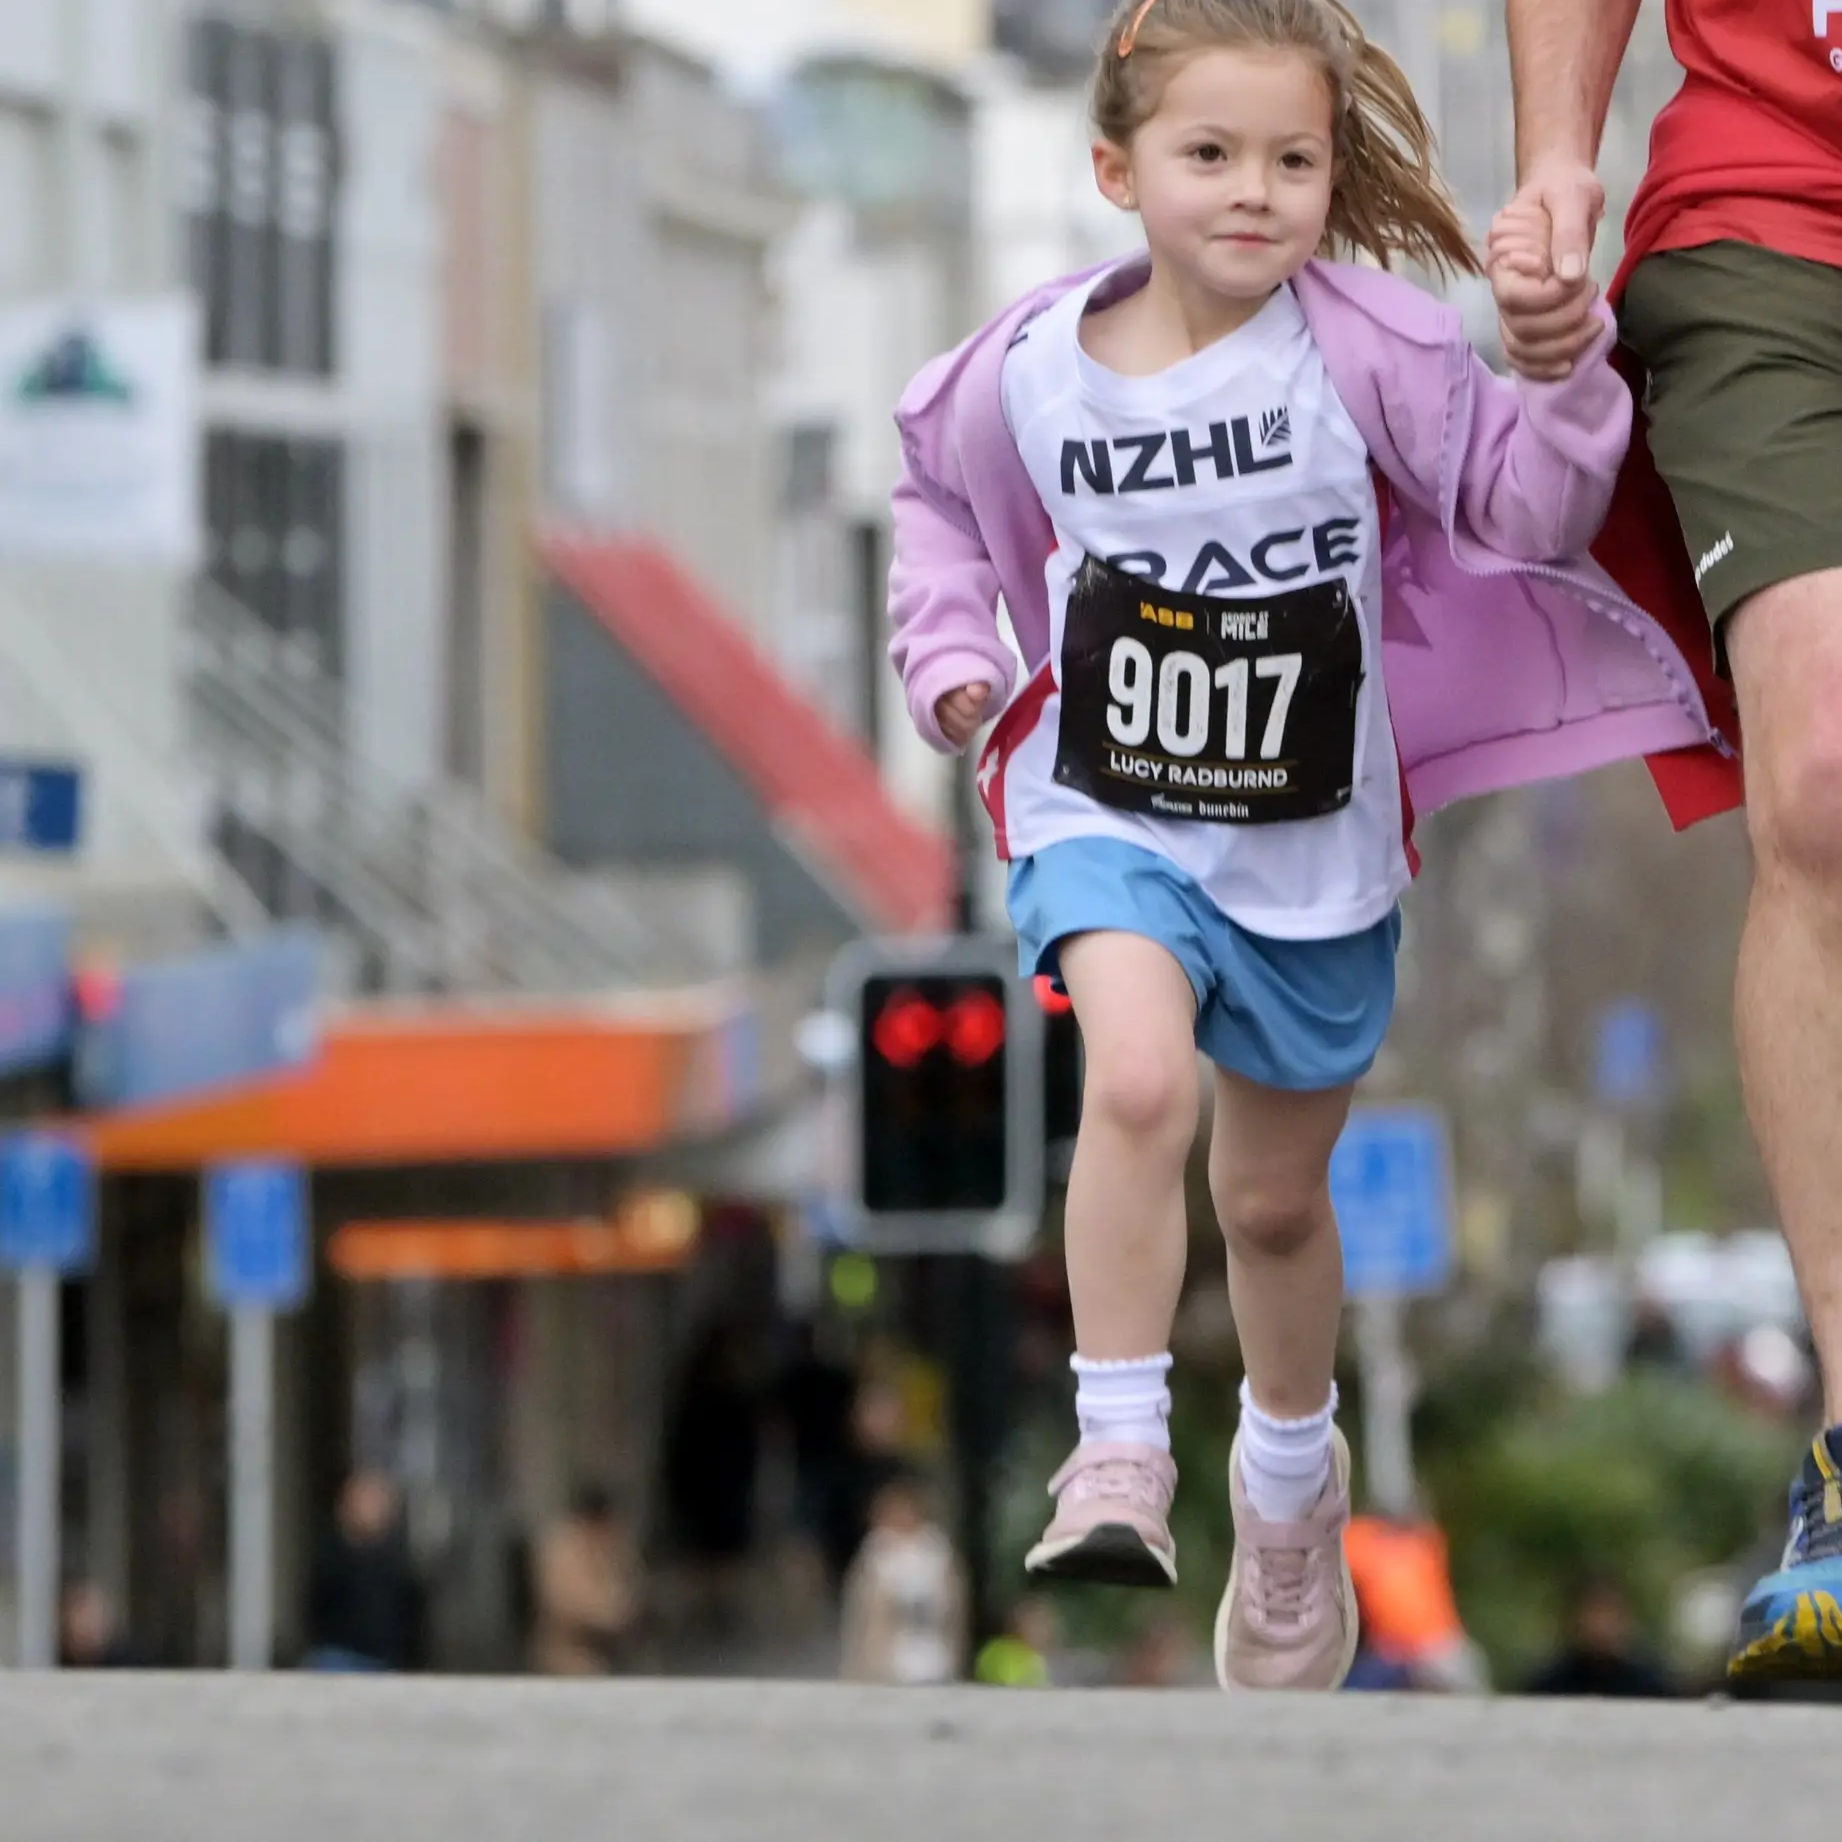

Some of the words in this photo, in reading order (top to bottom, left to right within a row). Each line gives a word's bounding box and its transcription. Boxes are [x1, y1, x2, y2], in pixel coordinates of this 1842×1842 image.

[1060, 415, 1293, 495] NZHL
[1105, 635, 1303, 760] 9017
[1110, 750, 1163, 781] LUCY
[1167, 764, 1288, 789] RADBURND
